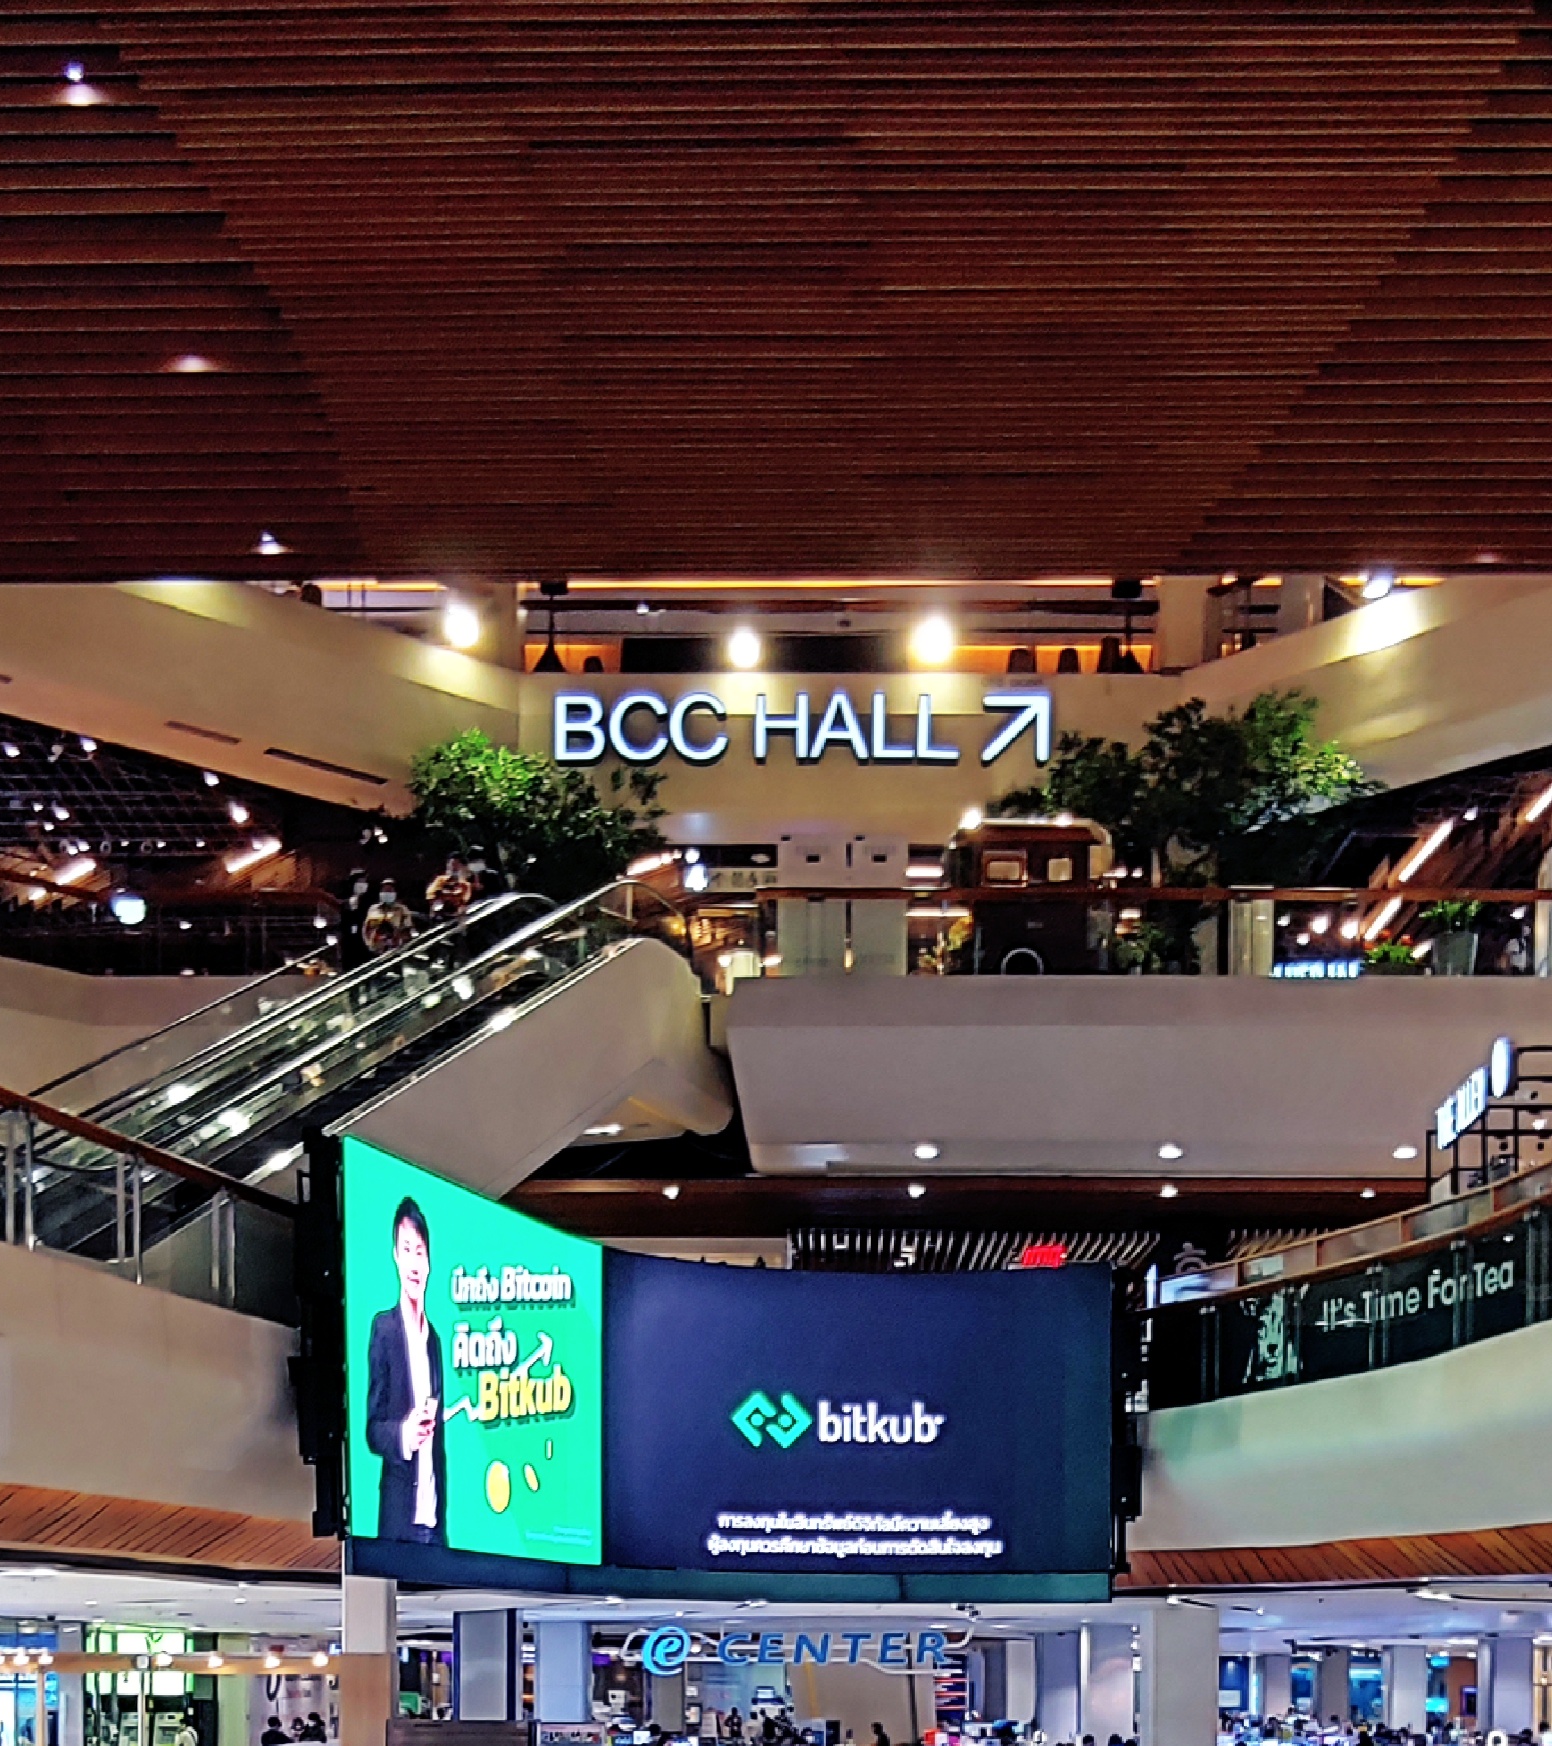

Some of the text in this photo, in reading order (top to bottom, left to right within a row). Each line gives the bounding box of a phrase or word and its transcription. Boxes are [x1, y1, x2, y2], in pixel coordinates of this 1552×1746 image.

[554, 692, 960, 762] BCC HALL
[500, 1265, 572, 1301] Bitcoin
[1323, 1260, 1514, 1333] It's Time For Tea
[478, 1363, 572, 1421] Bitkub
[817, 1400, 938, 1443] bitkub
[717, 1632, 949, 1665] CENTER
